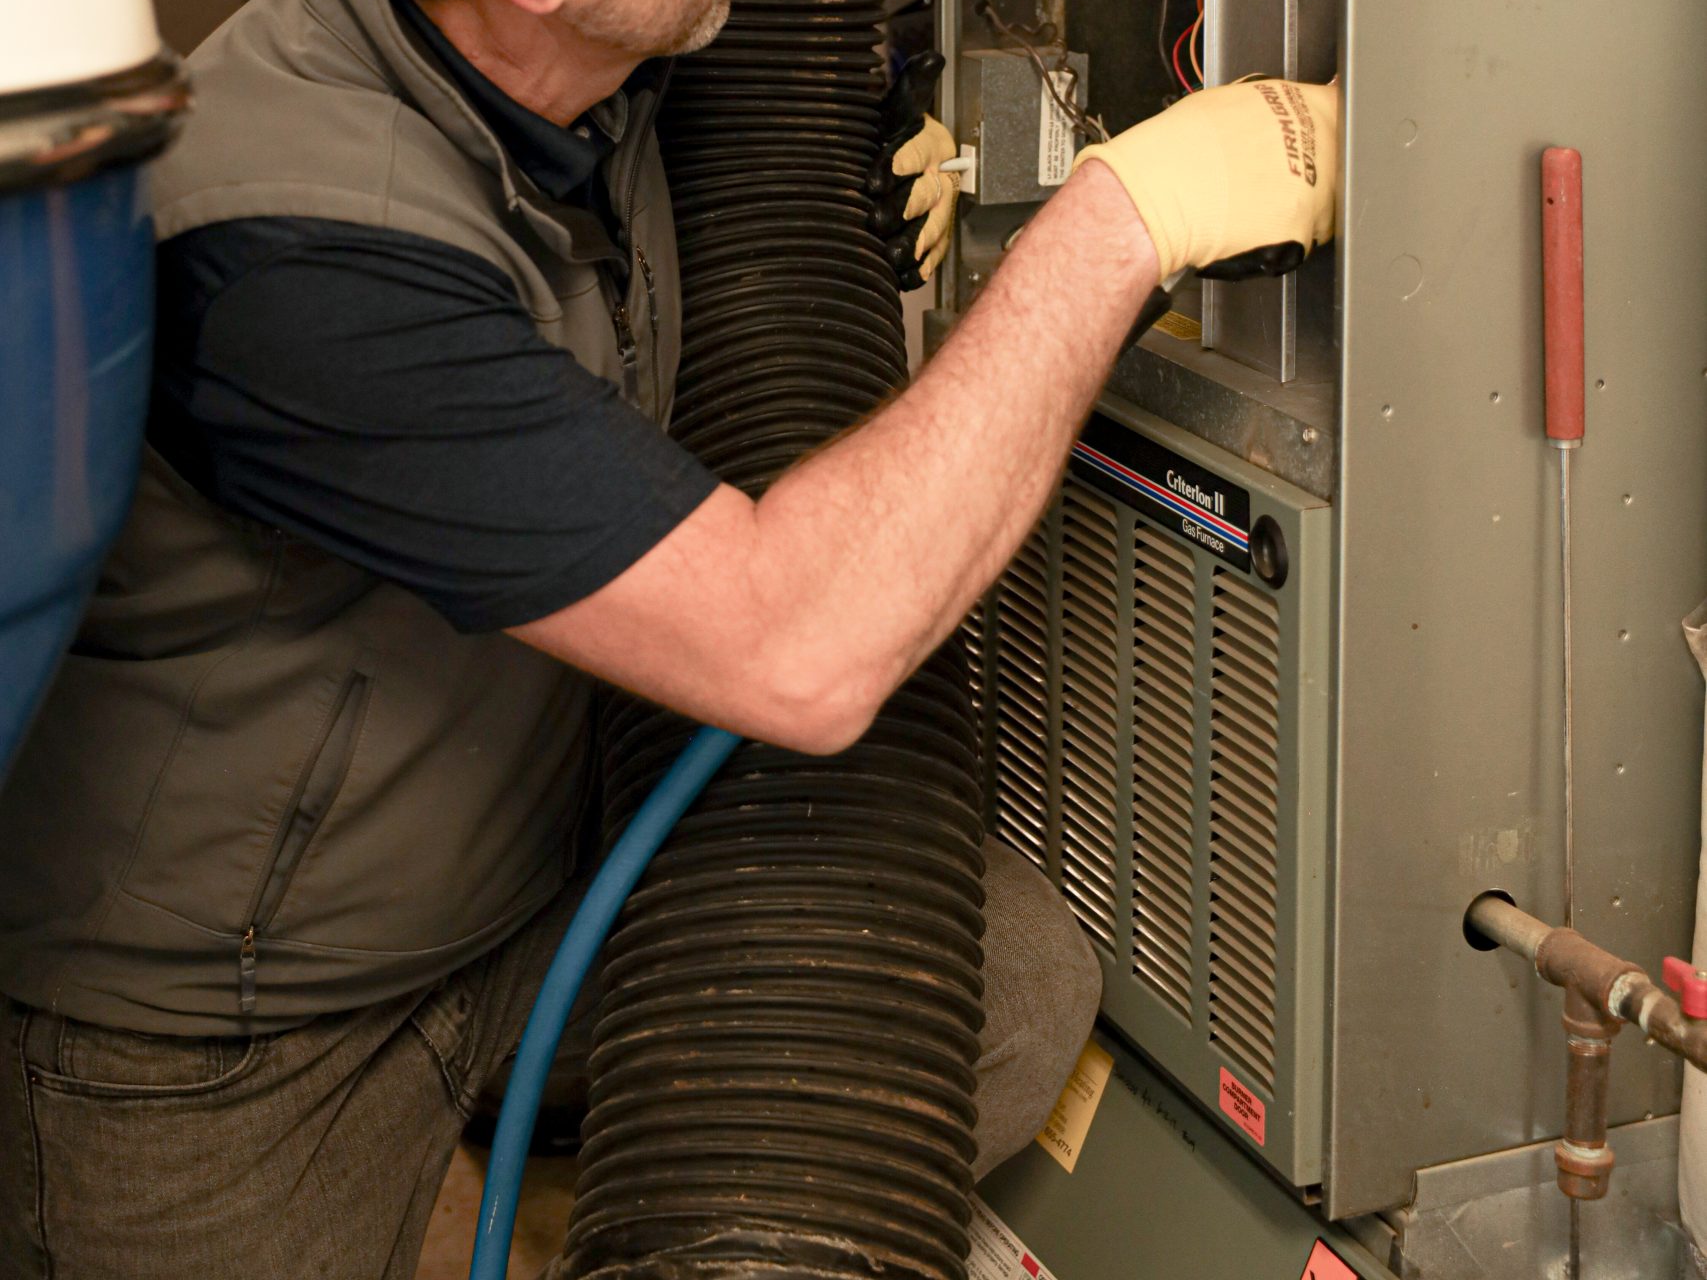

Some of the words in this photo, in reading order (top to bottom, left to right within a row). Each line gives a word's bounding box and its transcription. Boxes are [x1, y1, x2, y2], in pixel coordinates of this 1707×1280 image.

[1253, 83, 1289, 117] GRIP
[1278, 119, 1302, 177] FIRM
[1166, 469, 1212, 510] Criterion
[1214, 490, 1224, 516] II
[1182, 518, 1196, 538] Gas
[1196, 525, 1224, 553] Furnace
[1222, 1082, 1261, 1122] COMPARTMENT
[1231, 1081, 1252, 1106] BURNER
[1233, 1102, 1249, 1121] DOOR
